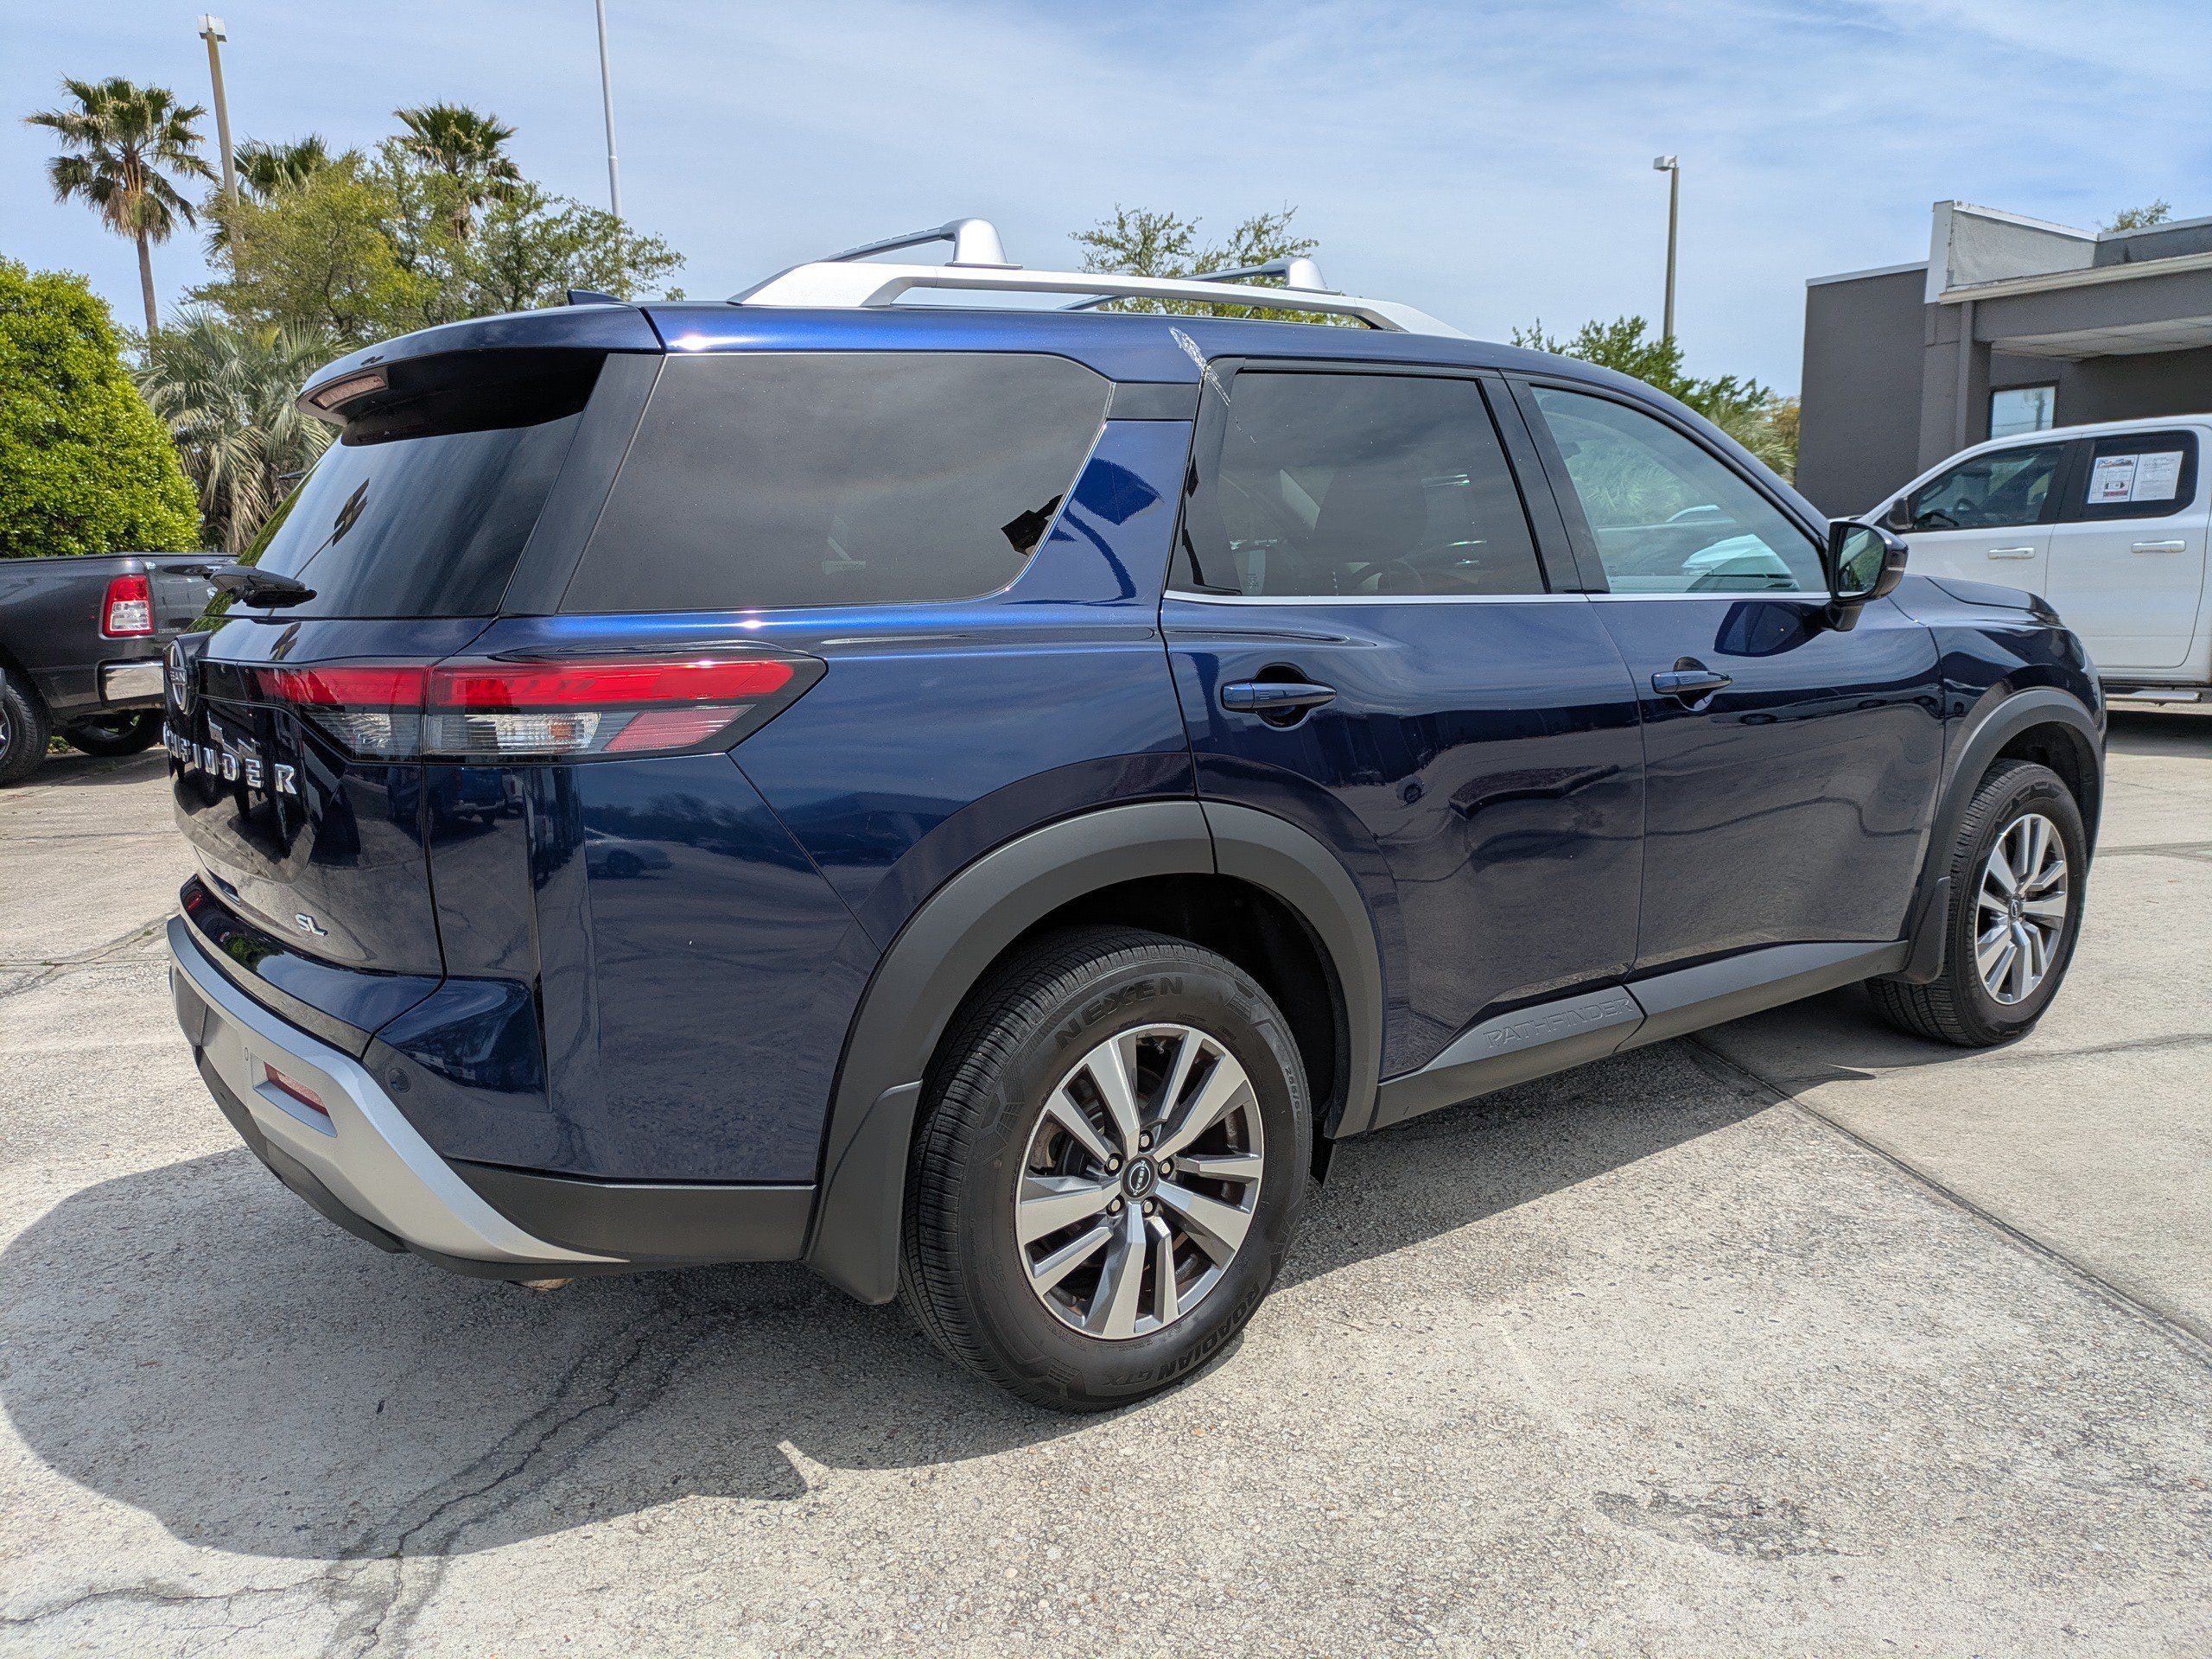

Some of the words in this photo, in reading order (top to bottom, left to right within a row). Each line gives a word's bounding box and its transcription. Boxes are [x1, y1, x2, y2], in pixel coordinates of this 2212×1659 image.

[295, 912, 328, 937] SL
[1053, 976, 1183, 1051] NEXEN
[1482, 996, 1634, 1049] PATHFINDER
[1133, 1160, 1146, 1195] NISSAN
[1156, 1281, 1261, 1382] ROADIAN
[1101, 1370, 1154, 1386] GTX
